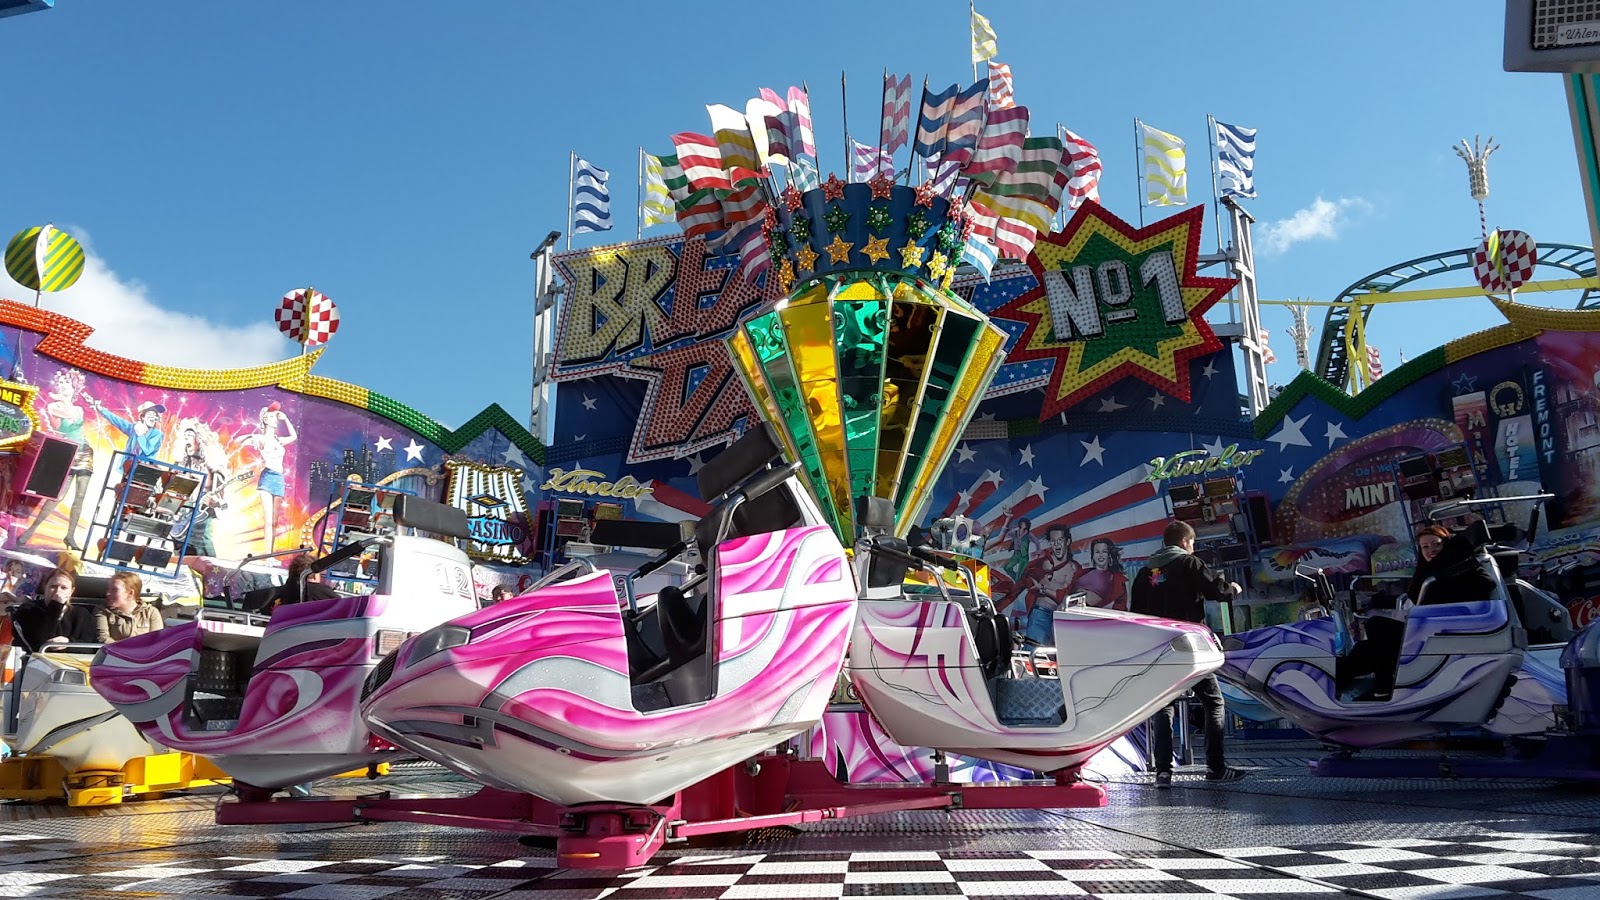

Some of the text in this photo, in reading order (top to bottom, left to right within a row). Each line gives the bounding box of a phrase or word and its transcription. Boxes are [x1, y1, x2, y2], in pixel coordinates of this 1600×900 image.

[1565, 27, 1600, 40] Uhlen
[564, 240, 788, 363] BREA
[0, 389, 21, 405] ME
[629, 339, 766, 451] DA
[1533, 370, 1555, 463] FREMONT
[1505, 422, 1519, 480] HOTEL
[1344, 481, 1396, 509] MINT
[1576, 600, 1600, 628] Co
